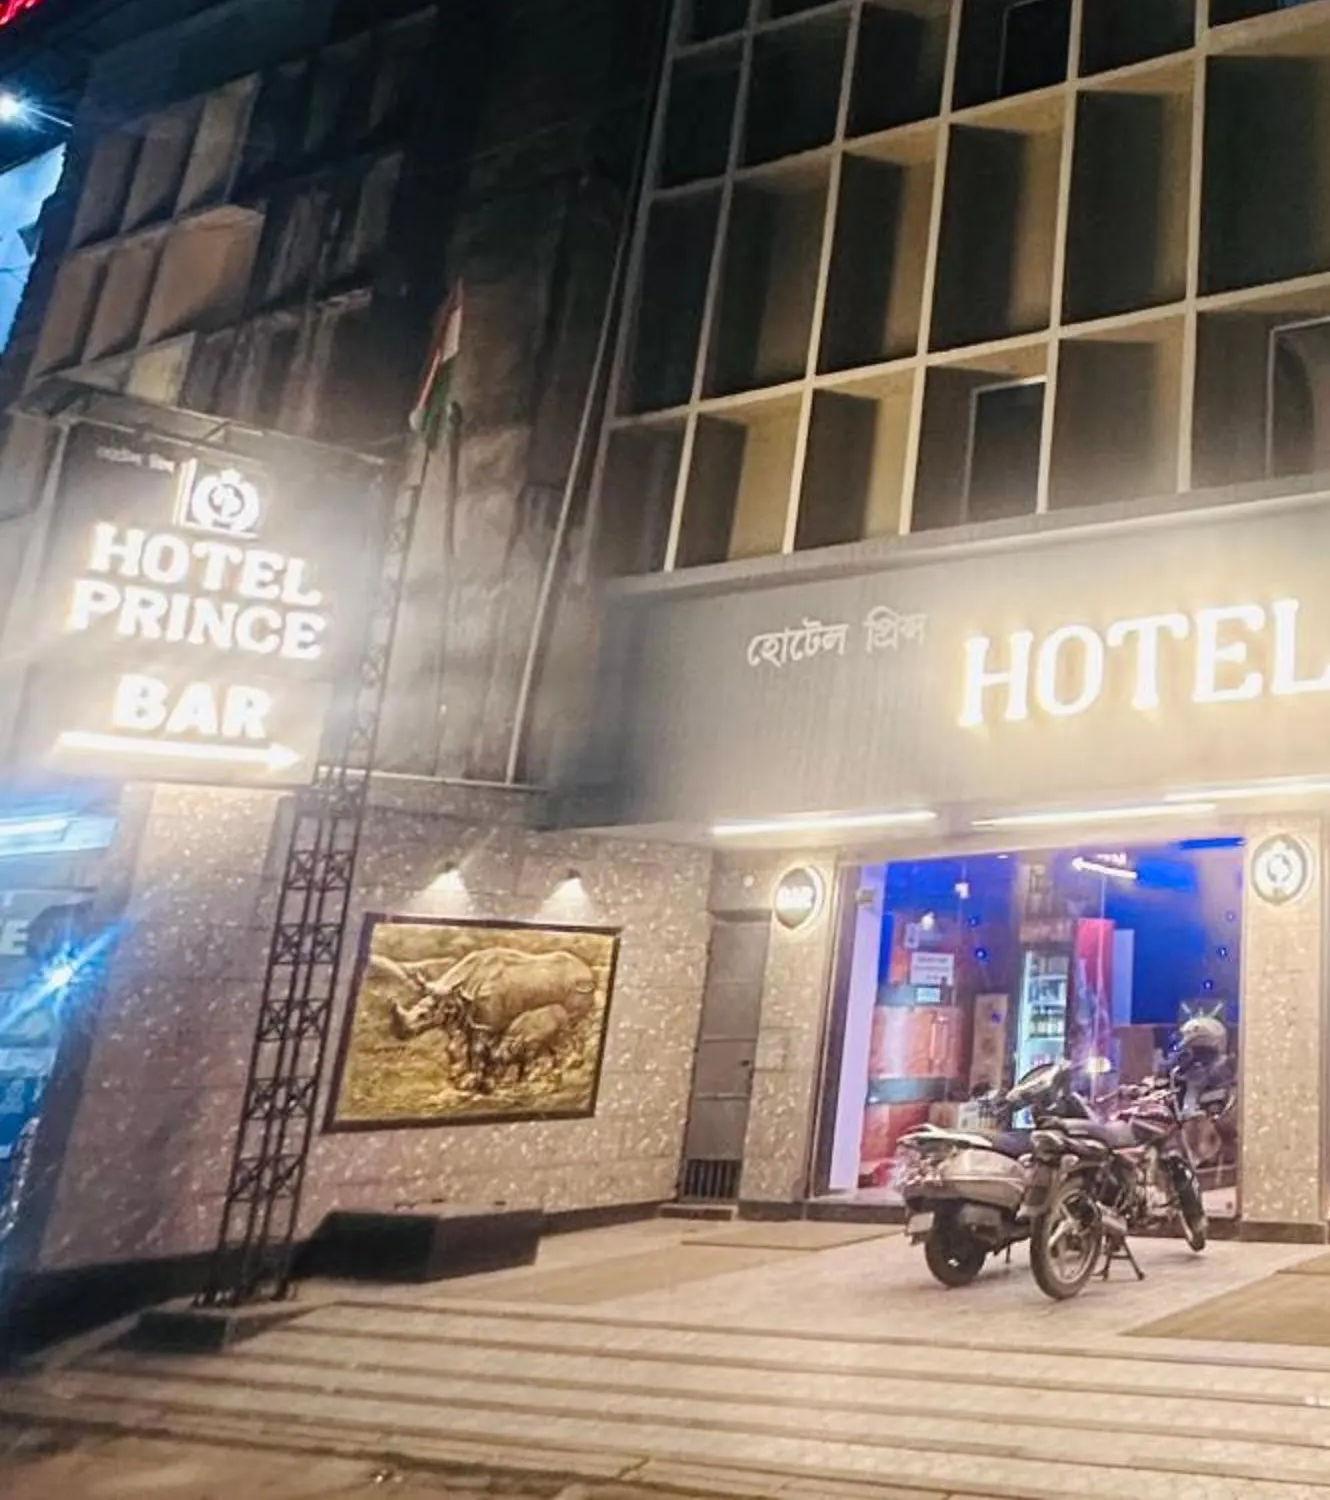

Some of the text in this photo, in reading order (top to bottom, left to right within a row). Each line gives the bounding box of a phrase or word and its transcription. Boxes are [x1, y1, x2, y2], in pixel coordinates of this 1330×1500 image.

[90, 522, 323, 606] HOTEL
[69, 579, 328, 660] PRINCE
[747, 617, 849, 668] হোটেল
[114, 673, 273, 739] BAR
